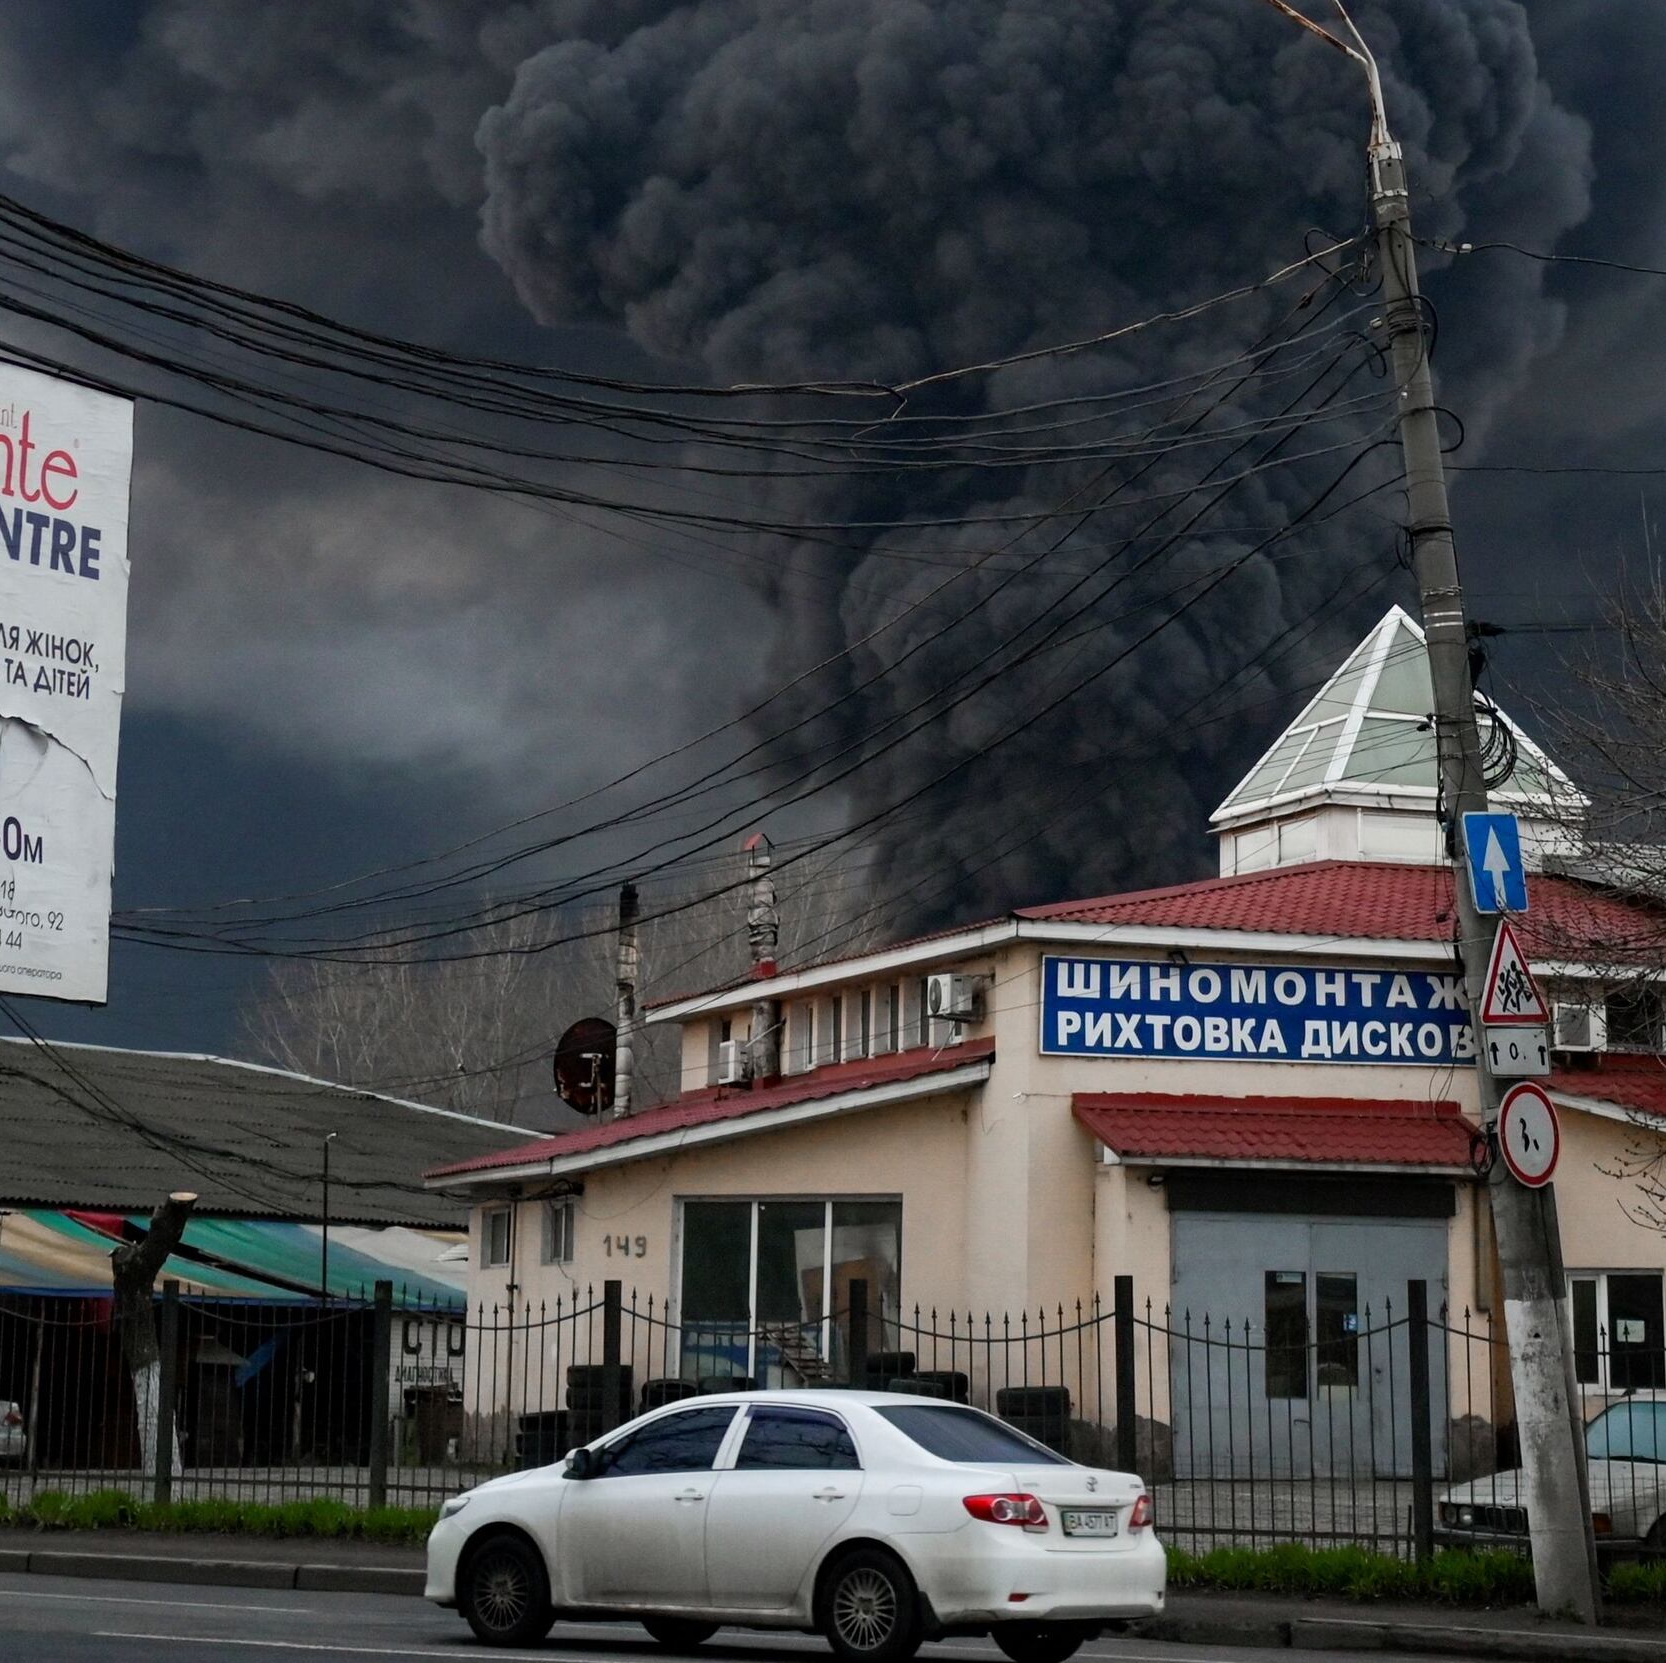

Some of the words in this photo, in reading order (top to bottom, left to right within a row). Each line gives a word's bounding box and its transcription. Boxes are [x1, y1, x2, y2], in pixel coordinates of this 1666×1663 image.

[24, 628, 99, 673] ЖІНОК,
[4, 657, 28, 687] ТА
[33, 665, 91, 700] ДІТЕЙ
[47, 911, 64, 931] 92
[5, 931, 23, 950] 44
[17, 964, 63, 981] оператора
[1056, 960, 1471, 1011] ШИНОМОНТАЖ
[1056, 1010, 1288, 1054] РИХТОВКА
[1300, 1020, 1476, 1059] ДИСКОВ
[603, 1234, 647, 1258] 149
